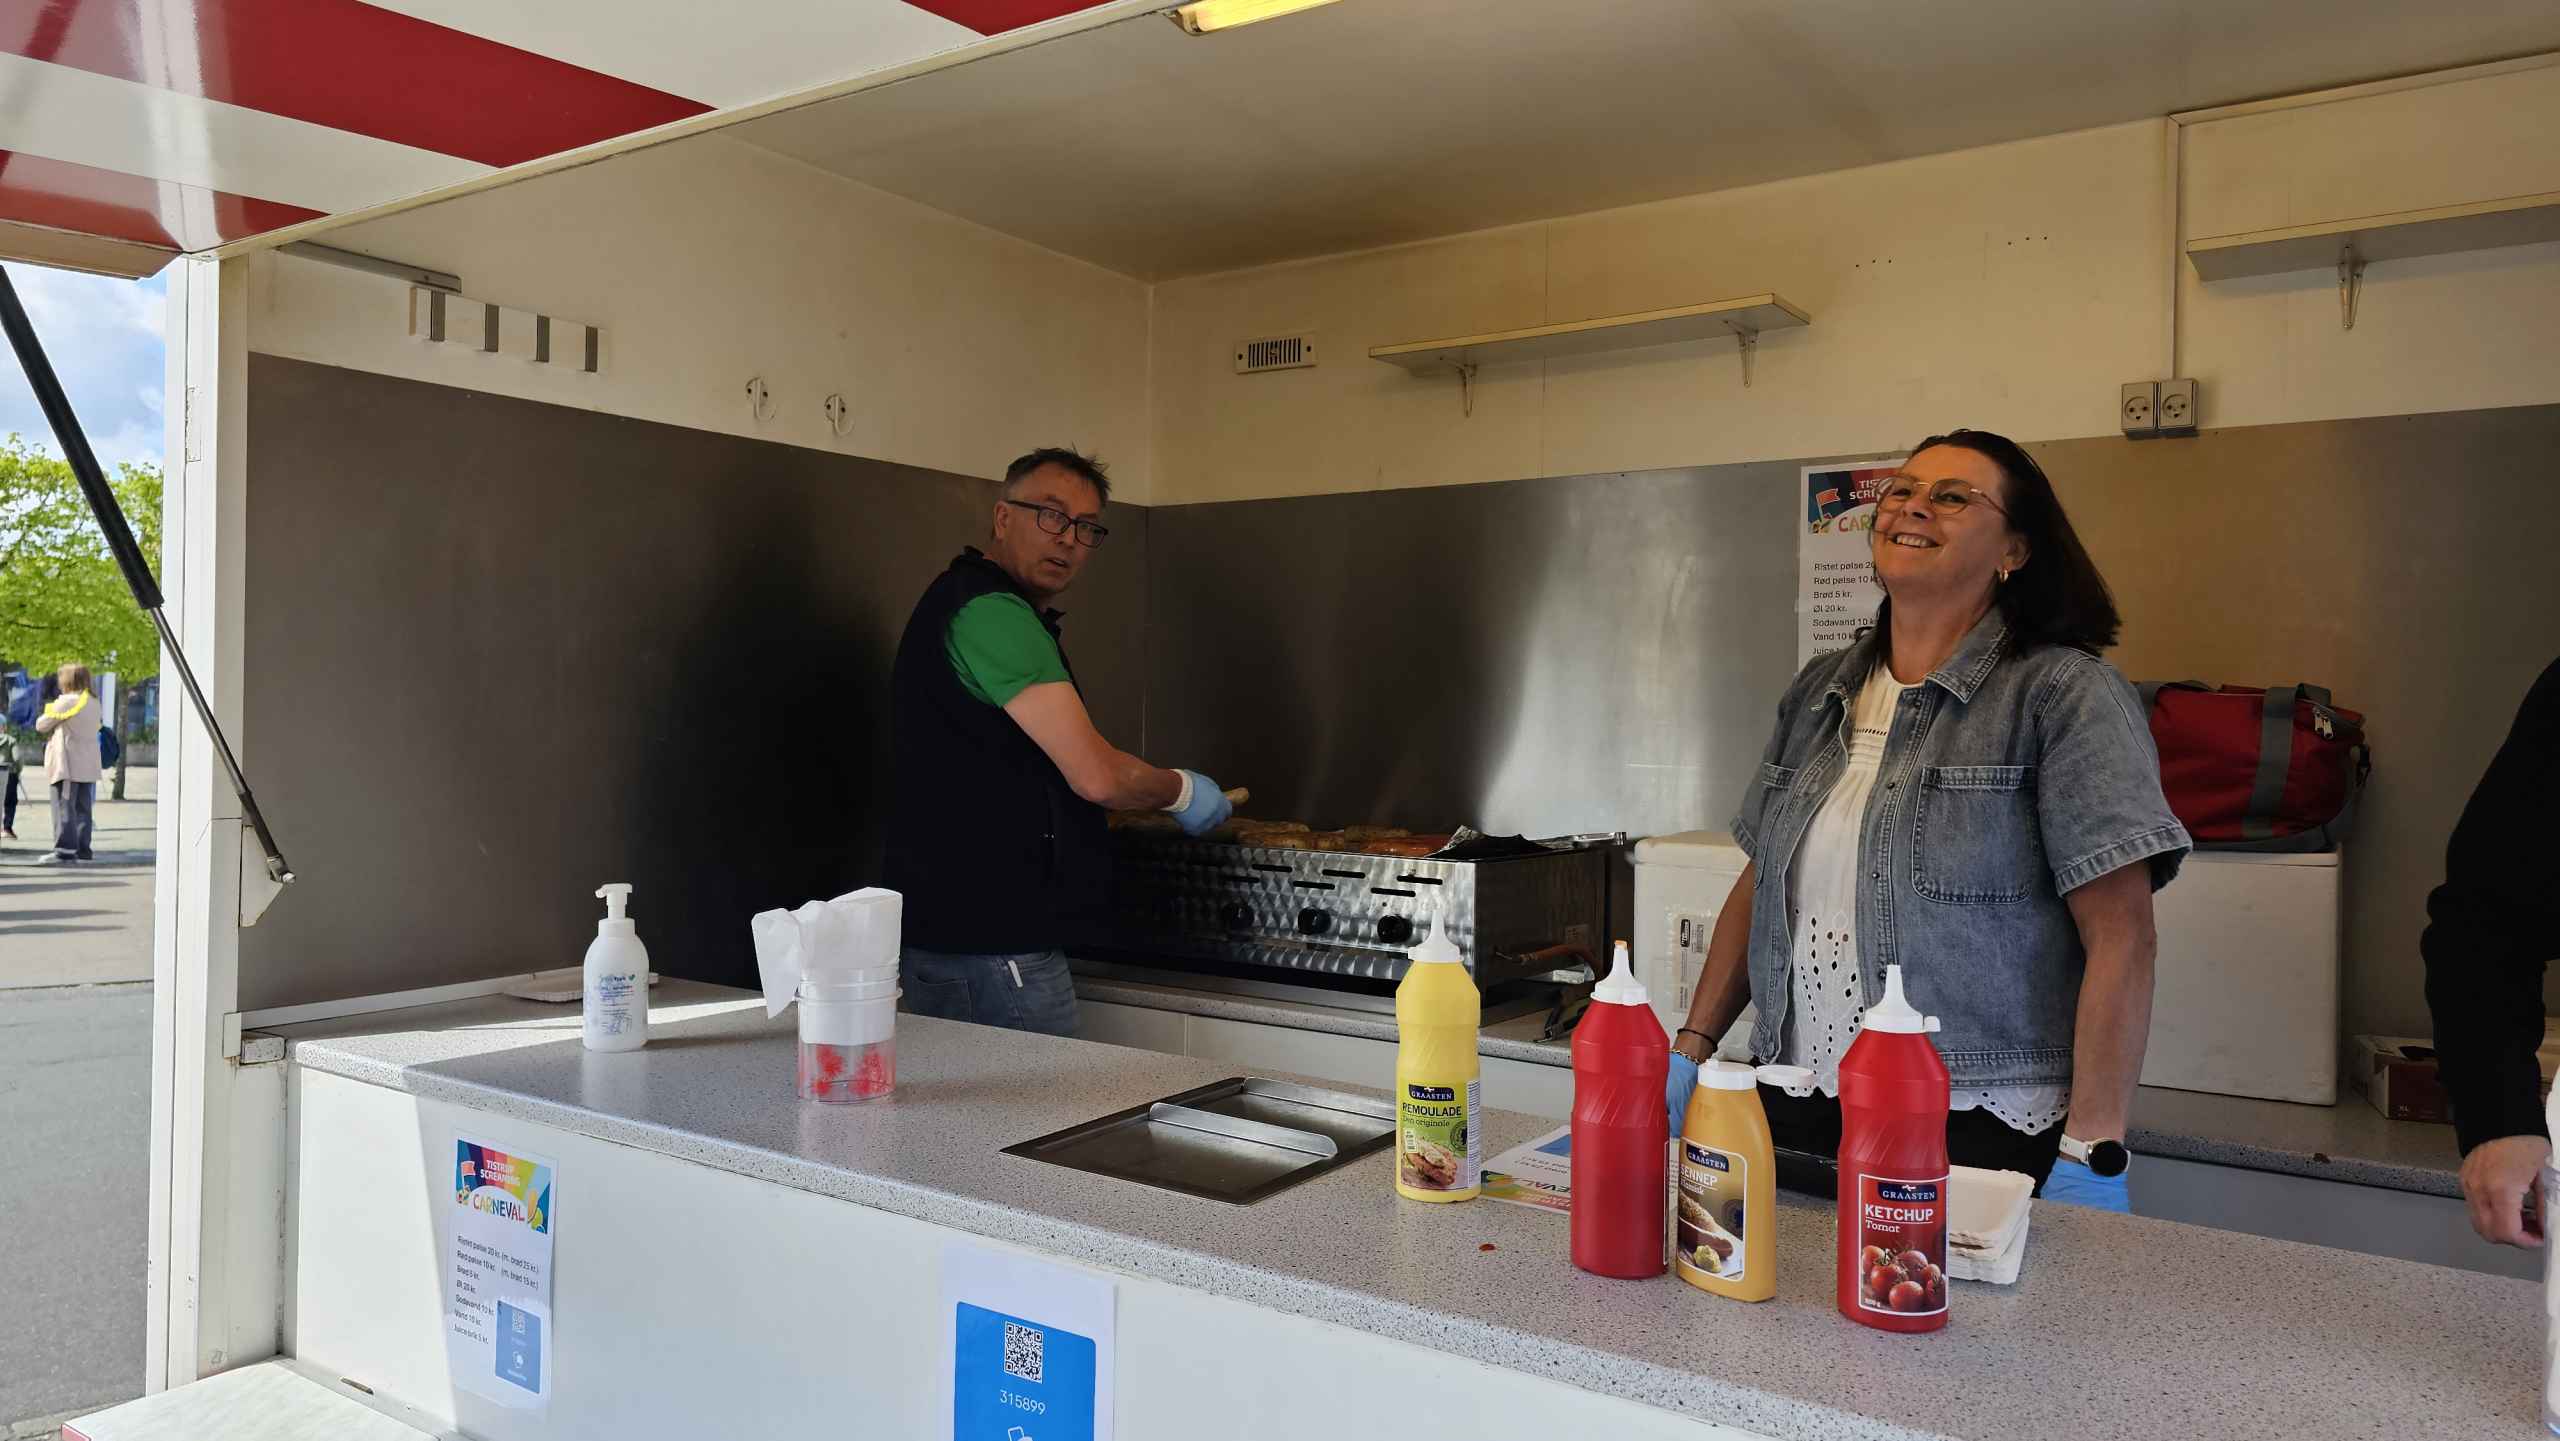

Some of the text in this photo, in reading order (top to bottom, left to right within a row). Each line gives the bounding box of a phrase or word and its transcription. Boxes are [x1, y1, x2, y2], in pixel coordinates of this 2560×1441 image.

[1838, 513, 1872, 532] CAR
[1814, 562, 1838, 571] Ristet
[1858, 576, 1868, 584] 10
[1814, 604, 1822, 612] Øl
[1825, 604, 1836, 612] 20
[1812, 618, 1856, 626] Sodavand
[1858, 618, 1868, 626] 10
[1812, 632, 1834, 640] Vand
[1837, 632, 1846, 640] 10
[1402, 1102, 1462, 1116] REMOULADE
[1680, 1164, 1718, 1186] SENNEP
[1882, 1190, 1935, 1200] GRAASTEN
[473, 1194, 526, 1222] CARNEVAL
[1865, 1203, 1934, 1221] KETCHUP
[1866, 1220, 1900, 1232] Tomat
[1000, 1388, 1046, 1415] 315899
